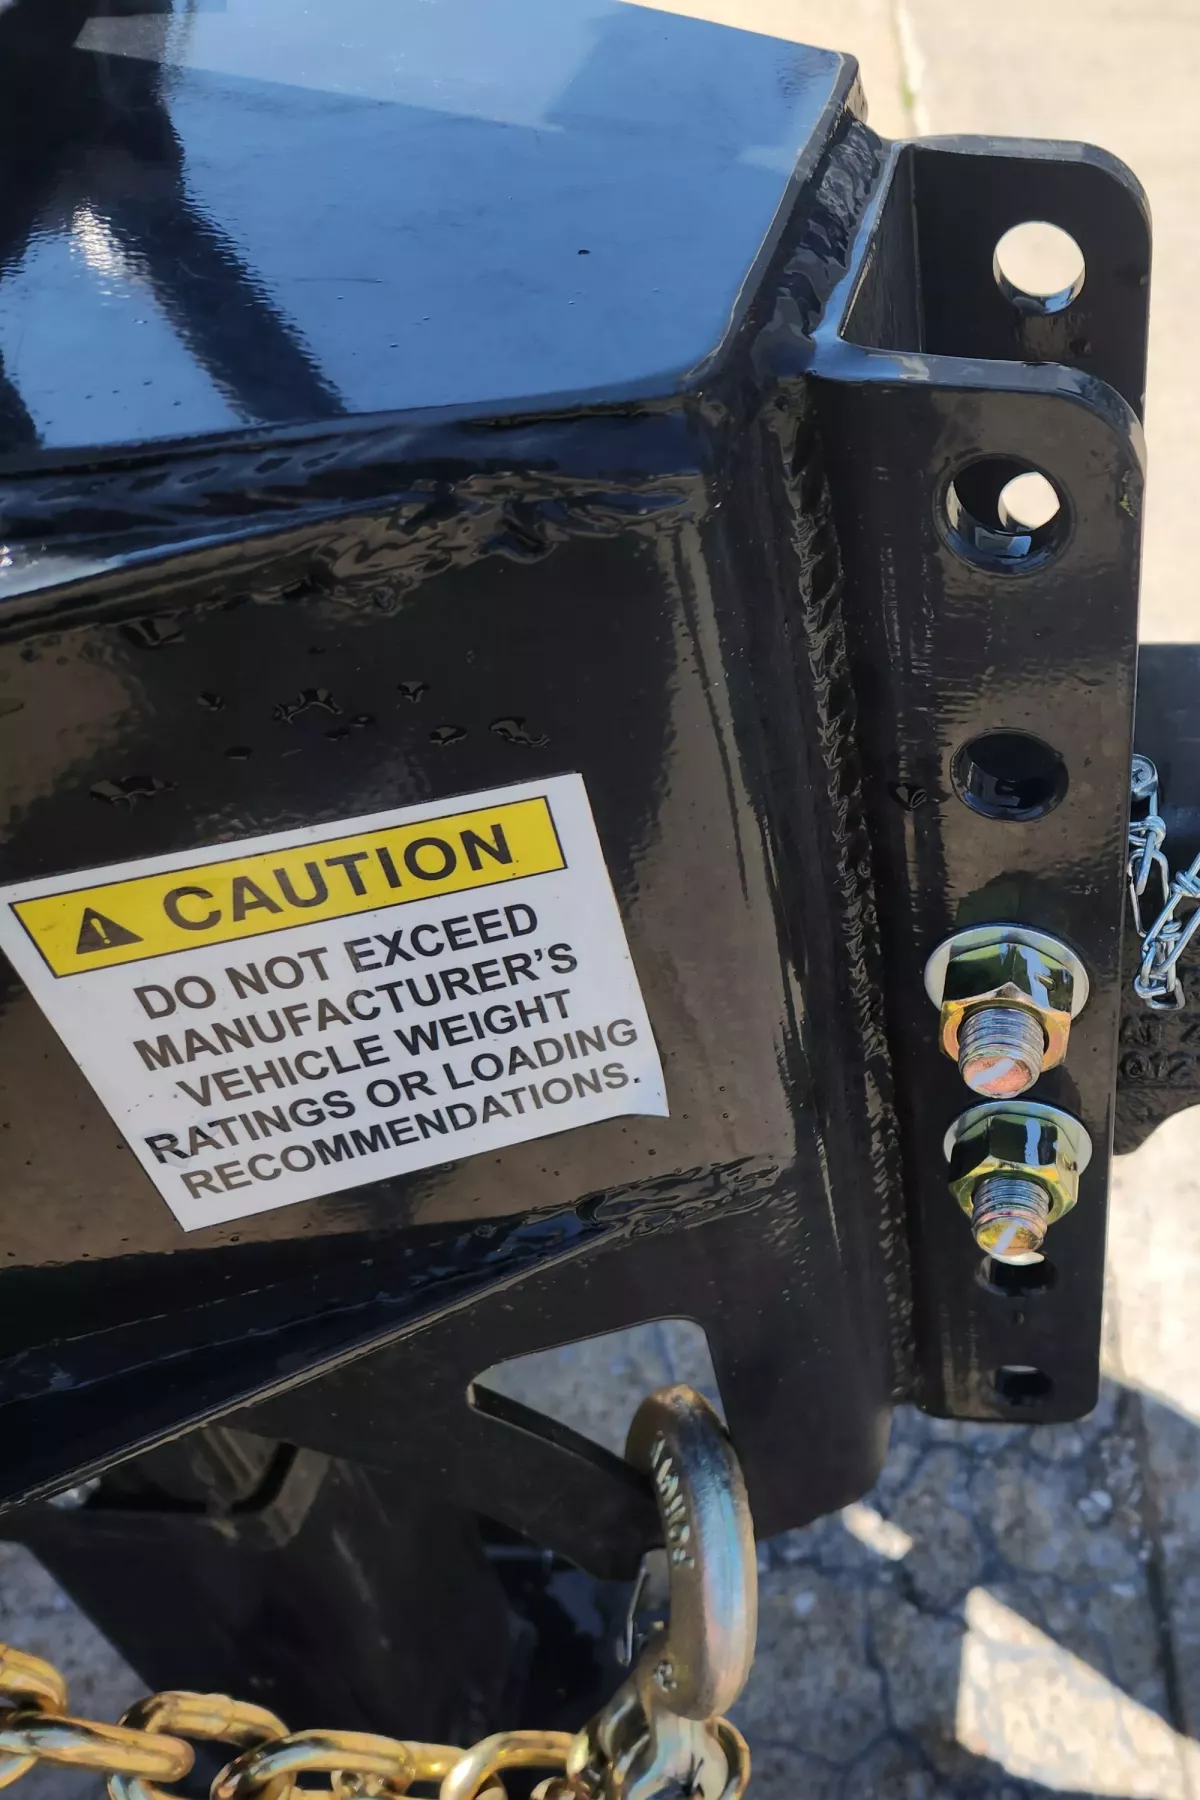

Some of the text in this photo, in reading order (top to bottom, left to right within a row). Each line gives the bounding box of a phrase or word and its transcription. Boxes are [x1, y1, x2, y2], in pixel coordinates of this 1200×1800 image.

[163, 824, 513, 930] CAUTION
[133, 903, 539, 1020] DO NOT EXCEED
[133, 942, 578, 1071] MANUFACTURER'S
[143, 1018, 639, 1164] RATINGS OR LOADING
[176, 989, 571, 1107] VEHICLE WEIGHT
[179, 1062, 641, 1198] RECOMMENDATIONS.
